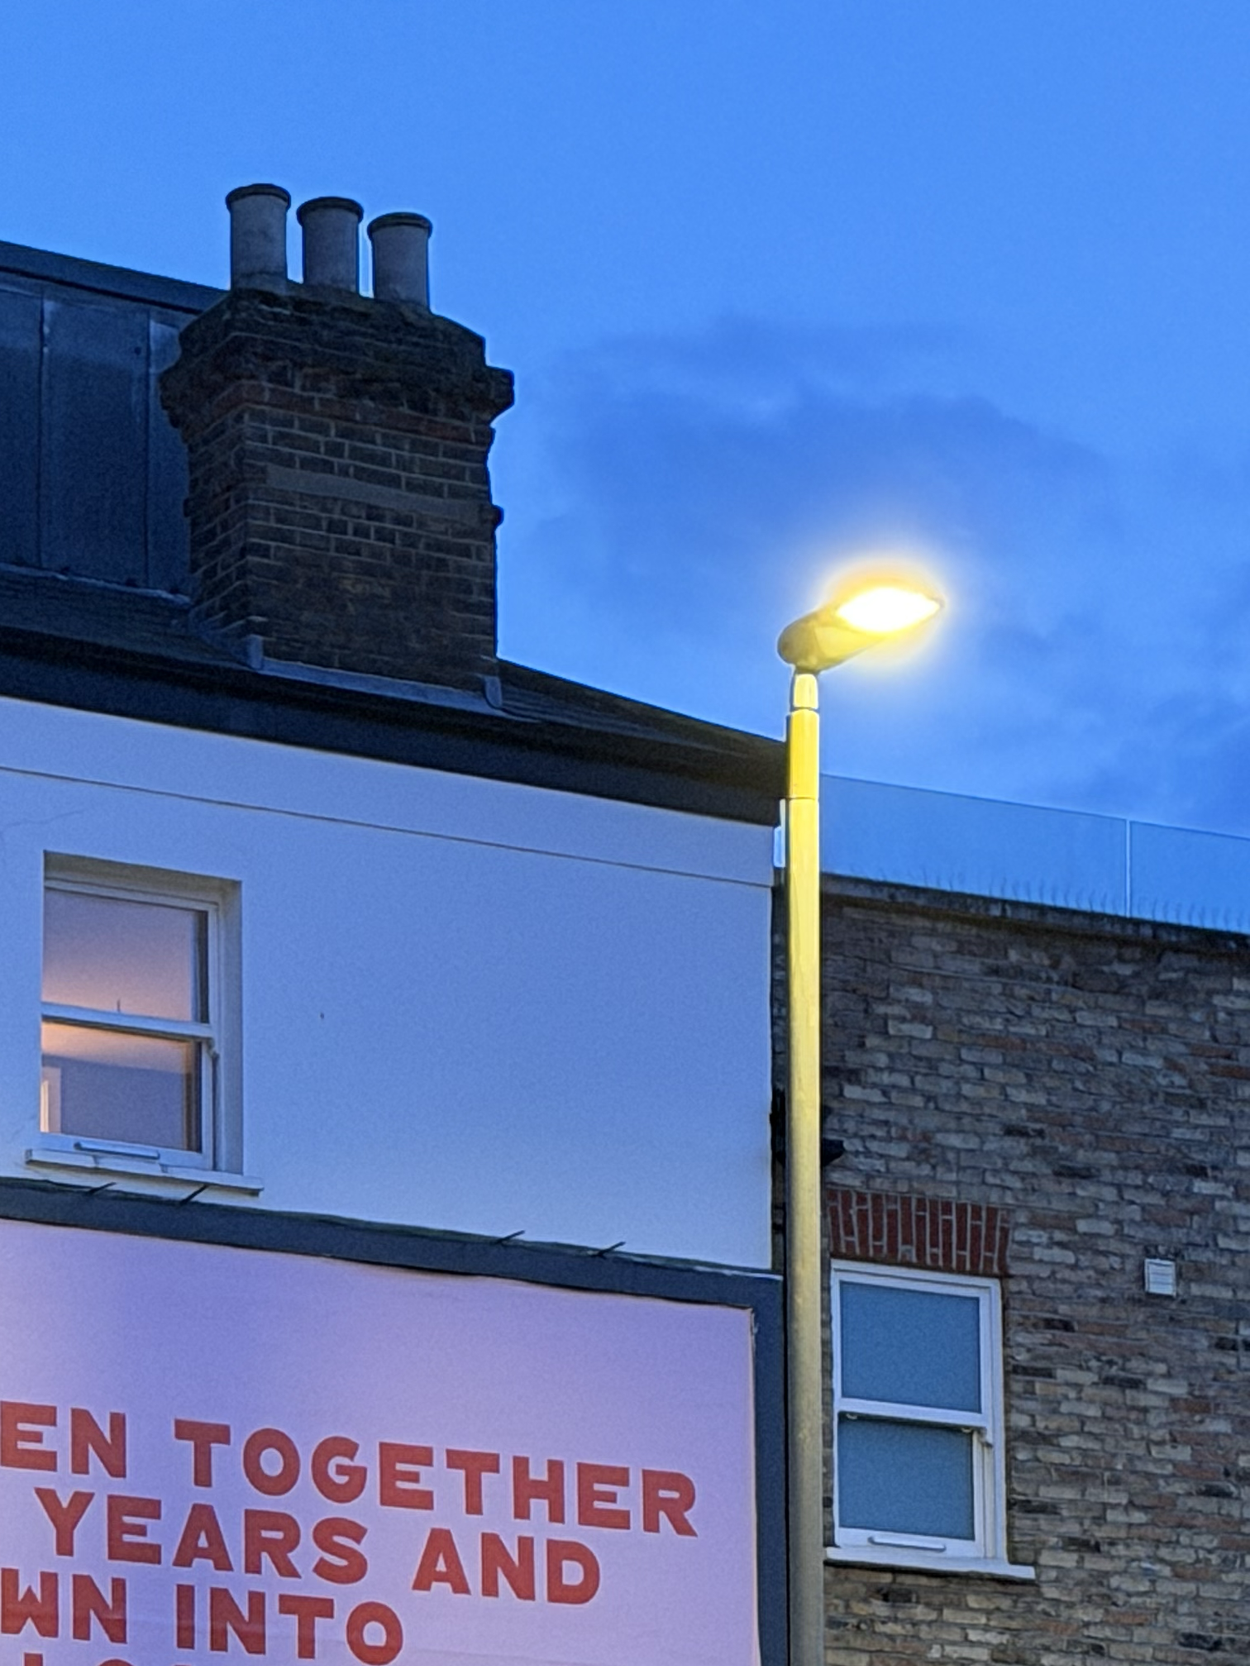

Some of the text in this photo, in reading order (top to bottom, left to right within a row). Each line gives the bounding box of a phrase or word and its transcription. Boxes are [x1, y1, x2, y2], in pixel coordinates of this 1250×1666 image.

[173, 1417, 698, 1537] TOGETHER
[34, 1486, 369, 1586] YEARS
[411, 1527, 601, 1606] AND
[176, 1583, 404, 1666] INTO
